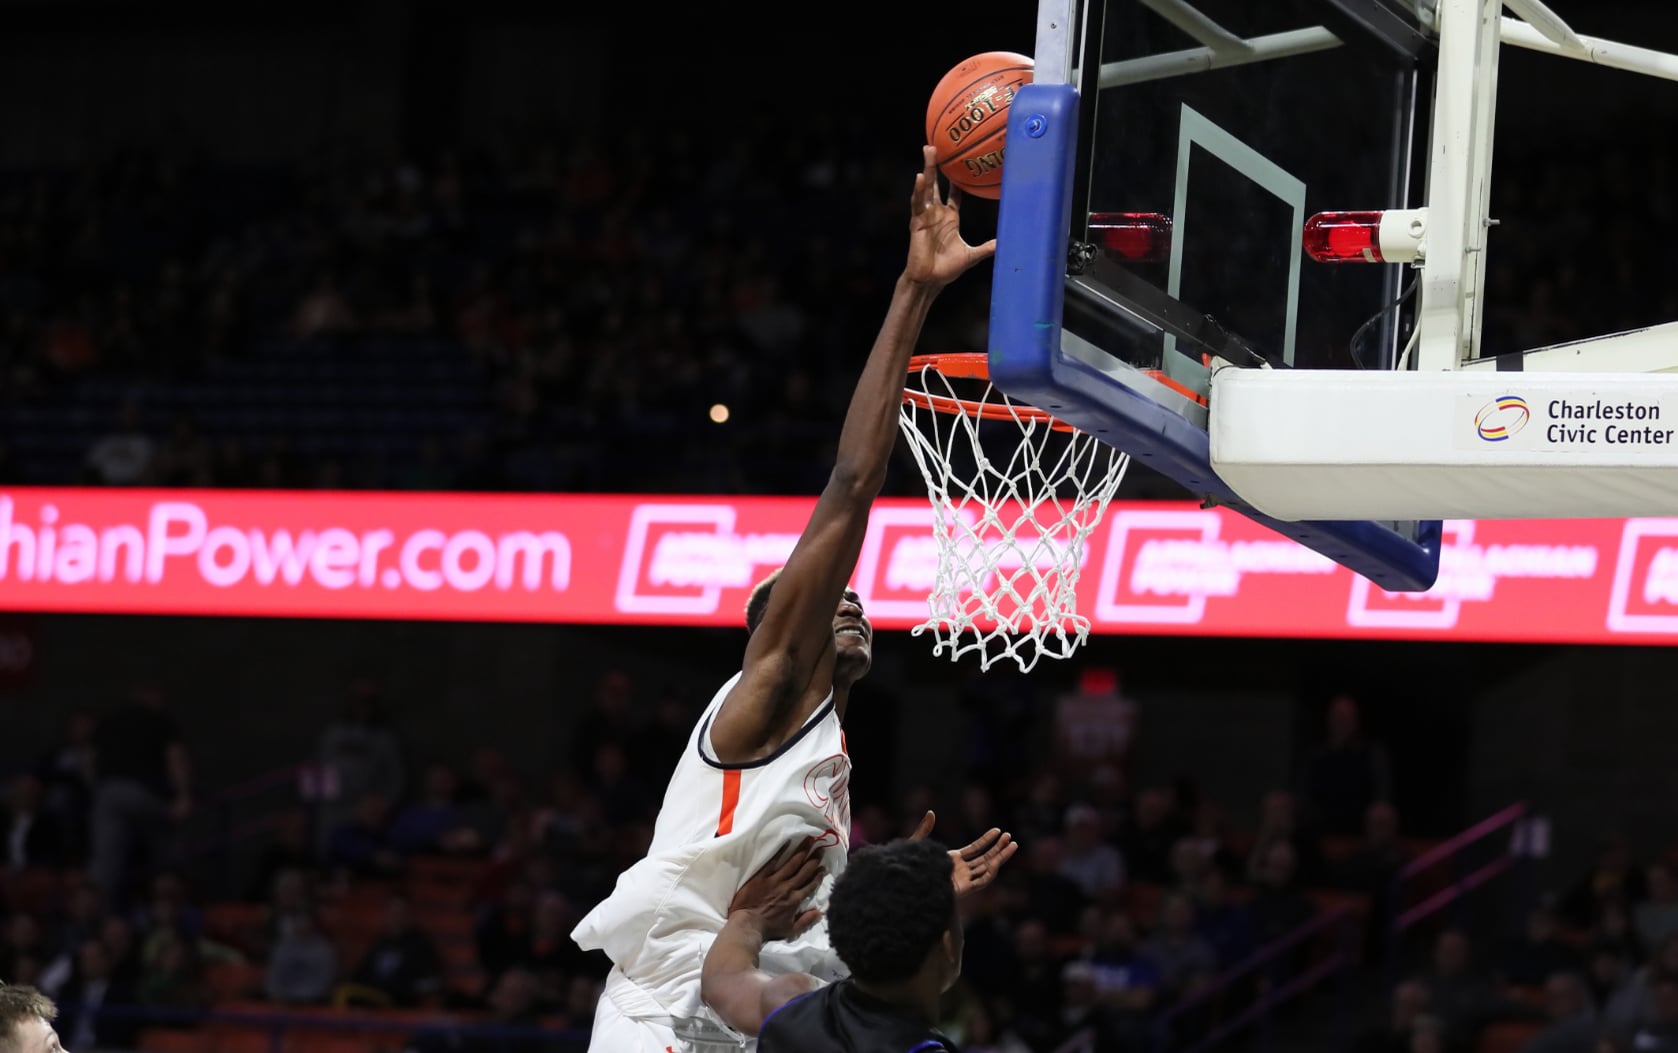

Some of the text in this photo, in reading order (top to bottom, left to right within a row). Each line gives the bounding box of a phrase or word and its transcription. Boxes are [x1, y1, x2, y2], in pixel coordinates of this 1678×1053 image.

[949, 82, 1022, 142] F-1000
[1548, 400, 1660, 420] Charleston
[1547, 424, 1674, 444] Civic Center
